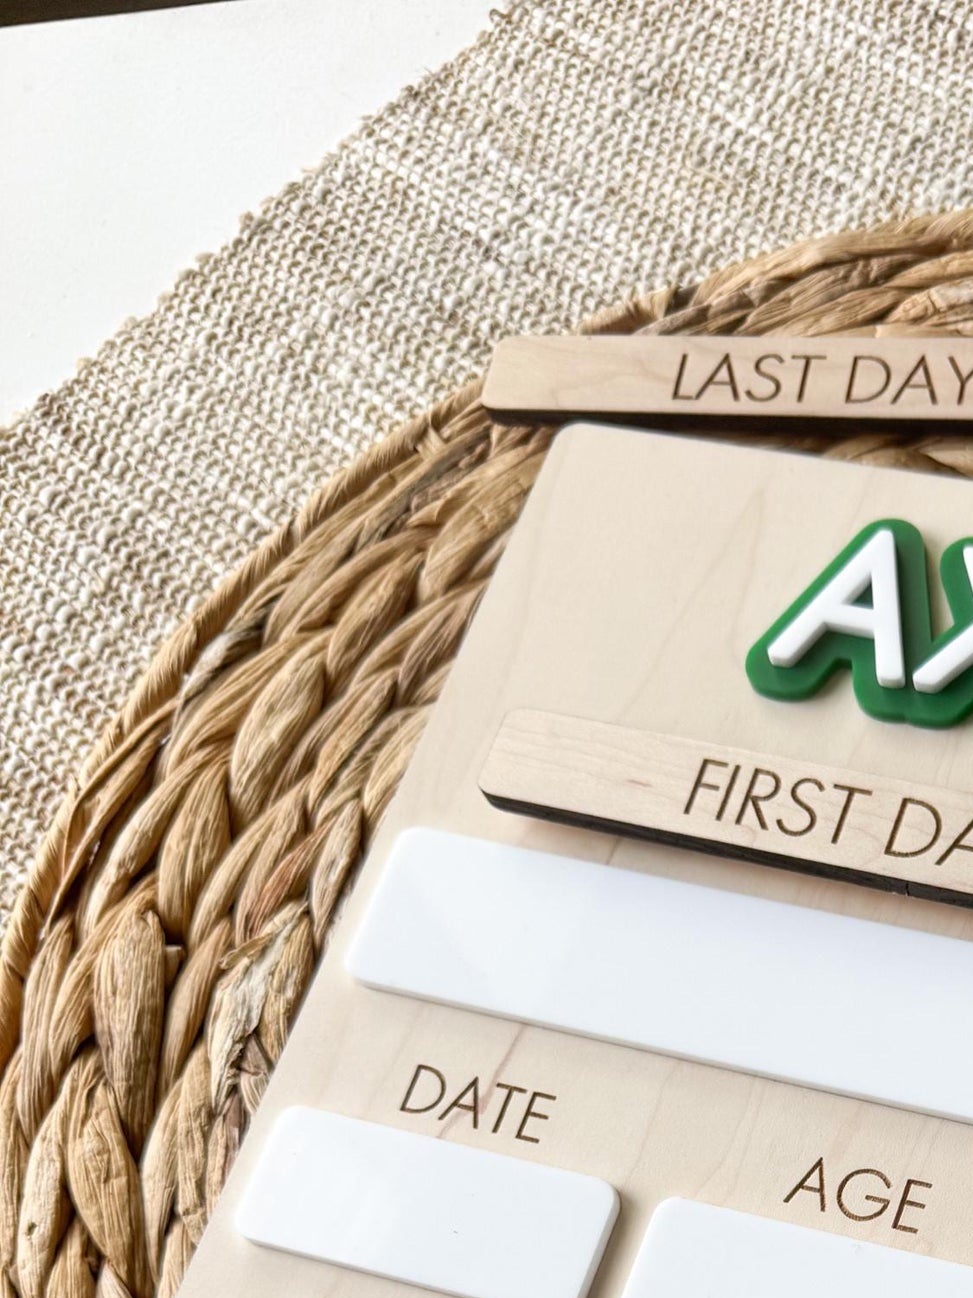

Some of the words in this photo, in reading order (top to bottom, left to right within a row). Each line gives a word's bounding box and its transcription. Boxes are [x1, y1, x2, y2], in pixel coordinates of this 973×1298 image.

[672, 353, 826, 403] LAST
[683, 757, 874, 846] FIRST
[400, 1064, 556, 1143] DATE
[783, 1157, 932, 1234] AGE
